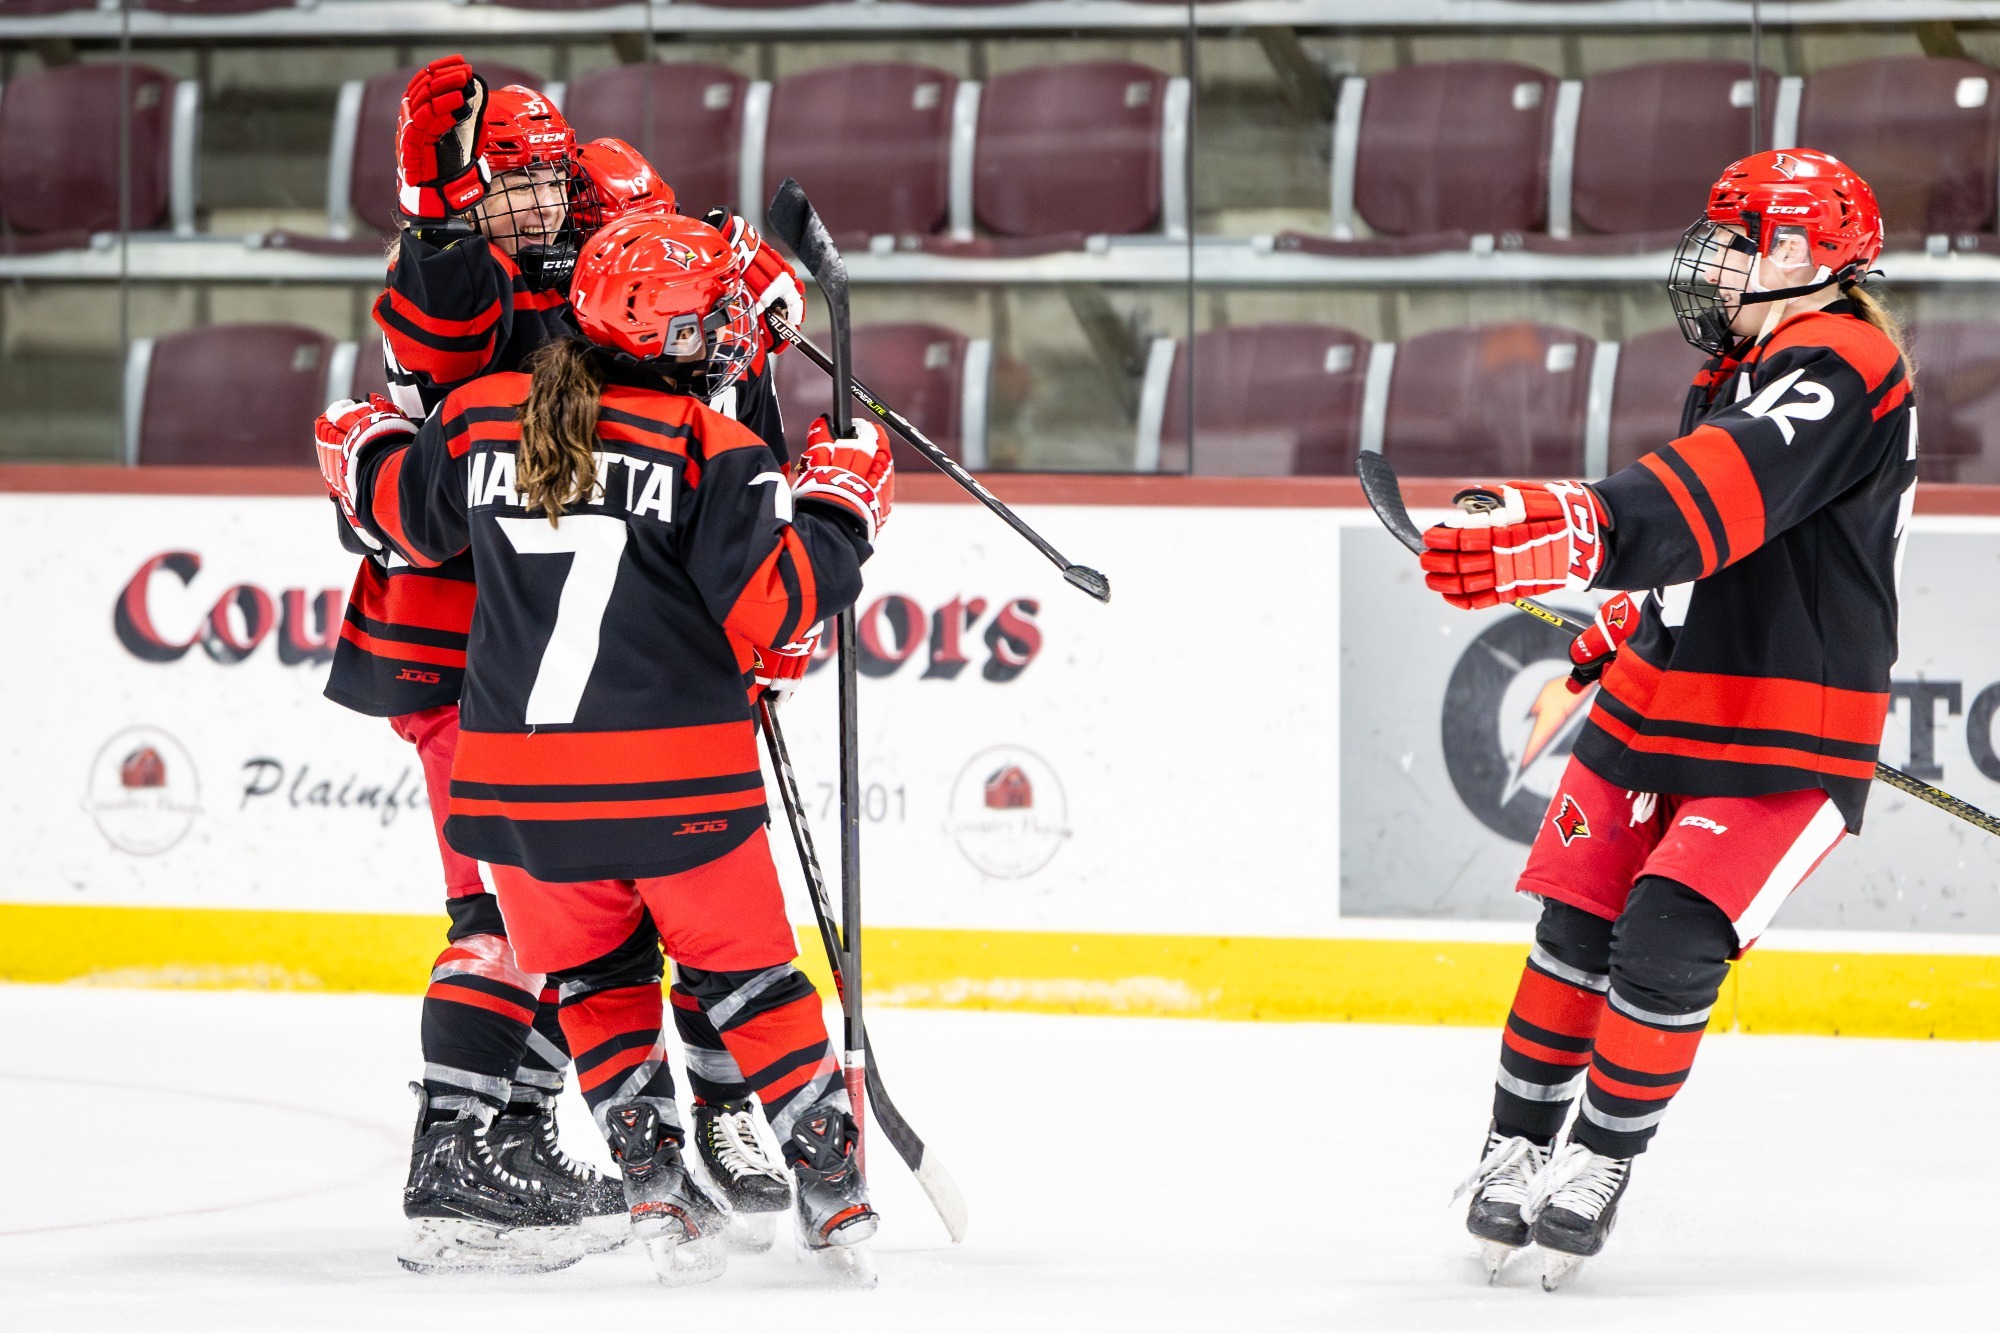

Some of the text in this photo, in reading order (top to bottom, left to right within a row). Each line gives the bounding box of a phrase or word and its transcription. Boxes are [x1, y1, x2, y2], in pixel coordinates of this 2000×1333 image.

[528, 132, 567, 144] CCM
[627, 176, 648, 195] 19
[1766, 205, 1811, 215] CCM
[542, 258, 575, 269] CCM
[768, 313, 802, 346] AUER
[1741, 367, 1835, 446] 12
[467, 451, 674, 523] MATTA
[495, 514, 628, 725] 7
[1519, 601, 1560, 625] CCM
[239, 755, 432, 828] Plainfi
